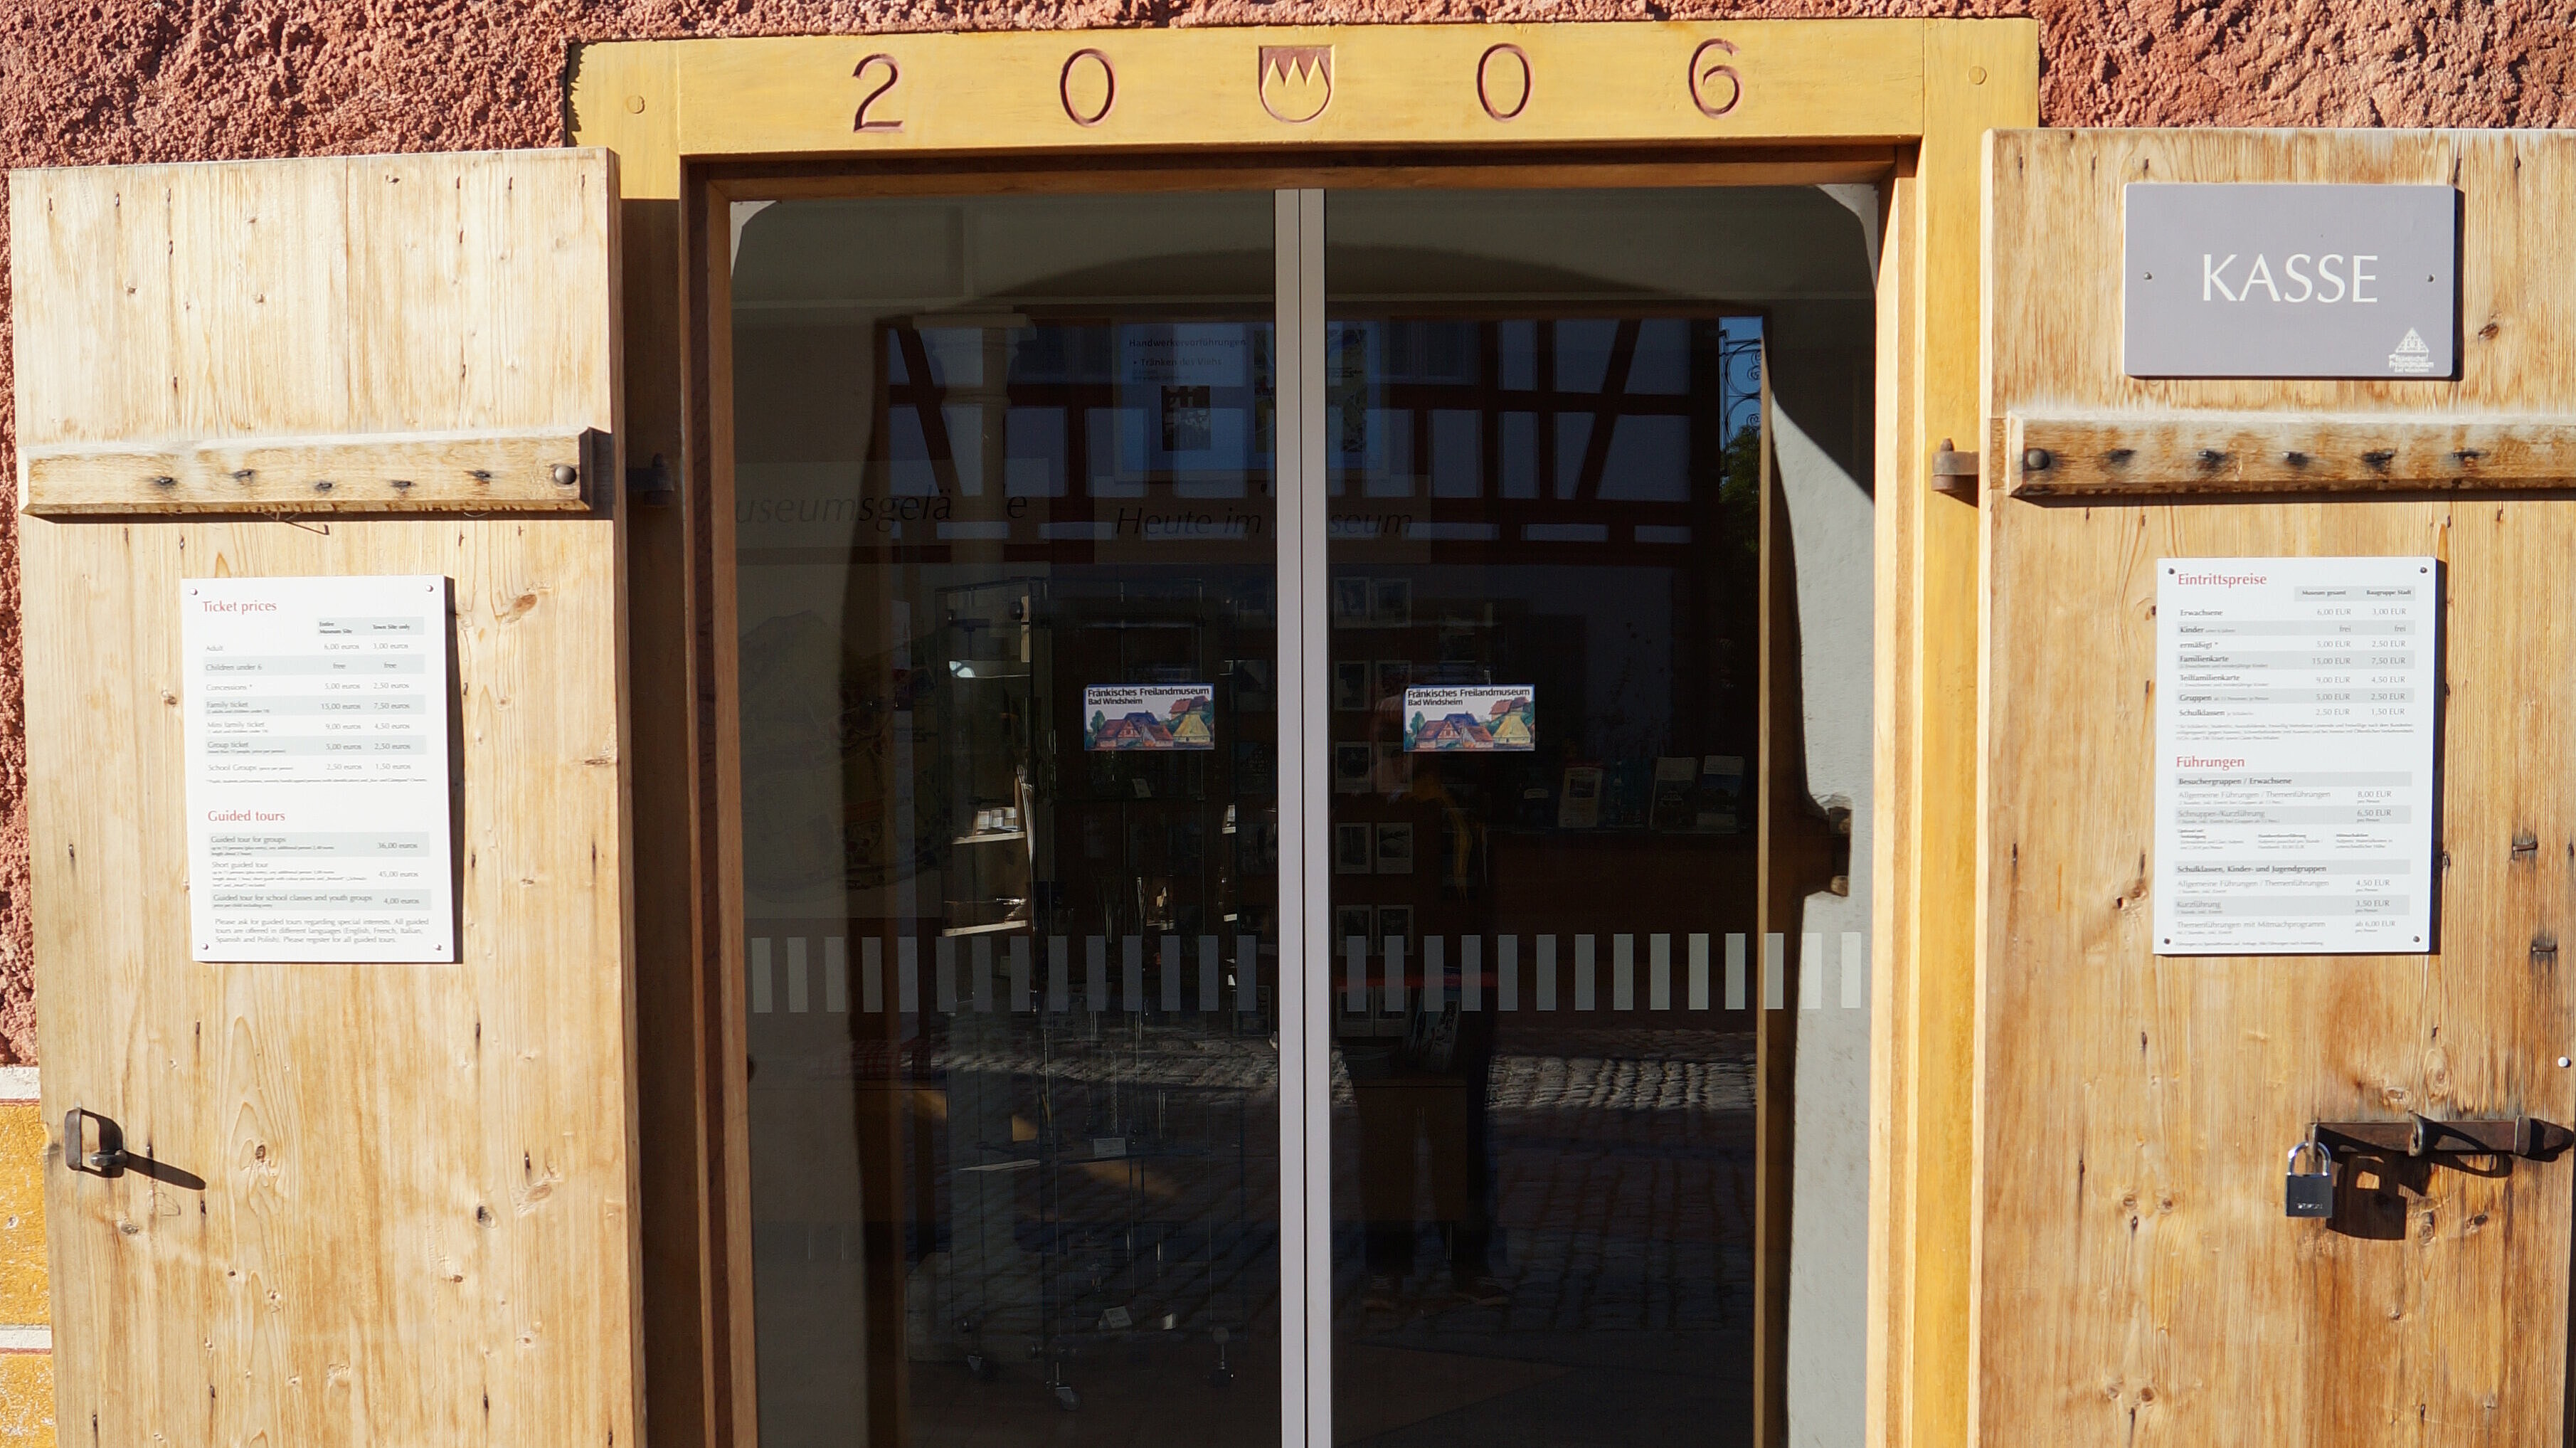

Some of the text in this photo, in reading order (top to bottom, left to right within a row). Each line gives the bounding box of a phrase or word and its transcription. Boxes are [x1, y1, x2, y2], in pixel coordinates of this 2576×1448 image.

[854, 39, 1742, 132] 2 0 0 6
[2203, 253, 2378, 302] KASSE
[1116, 507, 1212, 534] Heute
[1224, 507, 1261, 534] im
[2178, 573, 2267, 588] Eintrittspreise
[203, 601, 277, 615] Ticket prices
[2312, 657, 2333, 665] 15,00
[2371, 657, 2388, 665] 7,50
[1088, 687, 1209, 697] Fränkisches Freilandmuseum
[1408, 689, 1457, 698] Fränkisches
[2179, 694, 2212, 703] Gruppen
[2177, 756, 2244, 771] Führungen
[2178, 778, 2242, 786] Besuchergruppen
[208, 810, 285, 821] Guided tours
[2272, 865, 2326, 874] Jugendgruppen
